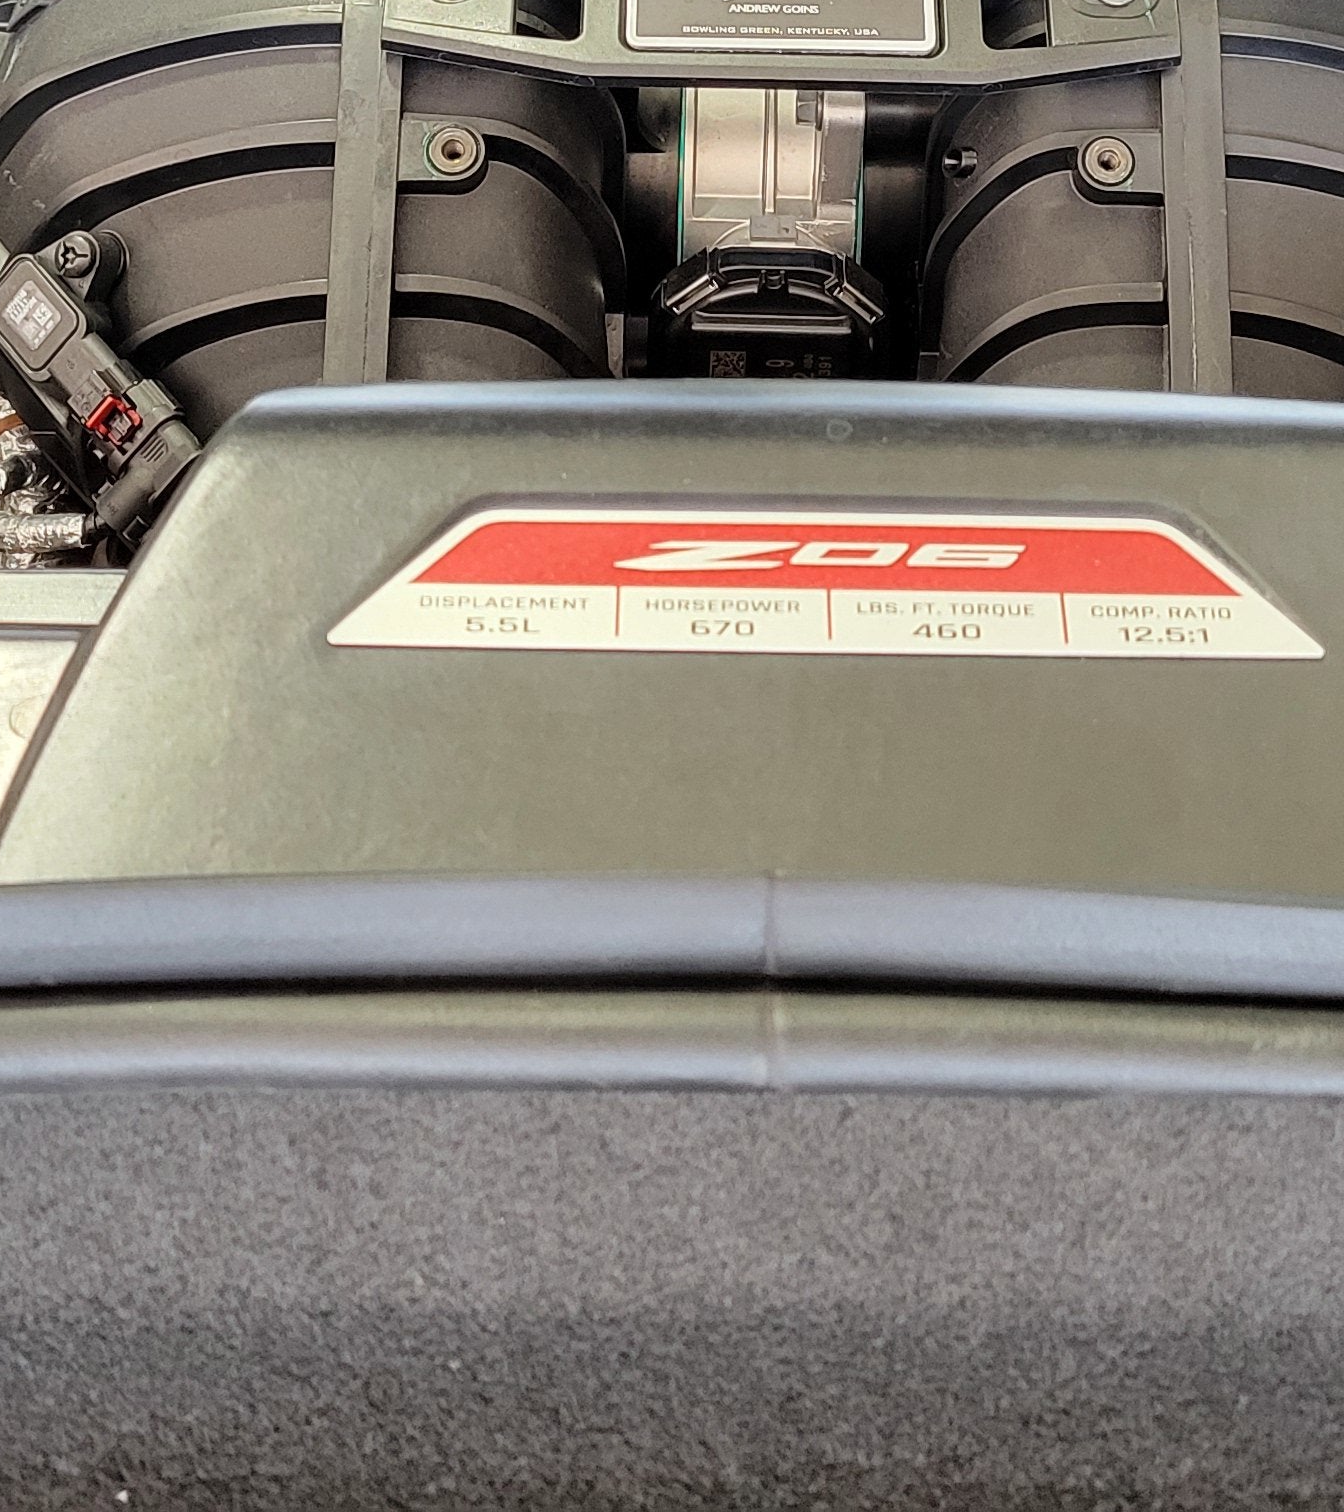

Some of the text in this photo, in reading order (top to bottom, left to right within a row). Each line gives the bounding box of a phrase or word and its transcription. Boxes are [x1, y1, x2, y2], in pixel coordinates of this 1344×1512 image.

[728, 4, 820, 14] ANDREW GOINS
[682, 26, 879, 36] BOWLING GREEN, KENTUCKY, USA
[613, 540, 1026, 572] Z06
[419, 595, 588, 610] DISPLACEMENT
[645, 598, 801, 614] HORSEPOWER
[856, 601, 1035, 618] LBS. FT. TORQUE
[1090, 605, 1232, 620] COMP. RATIO
[465, 616, 541, 634] 5.5L
[691, 619, 755, 637] 670
[912, 623, 982, 640] 460
[1118, 626, 1209, 644] 12.5:1
